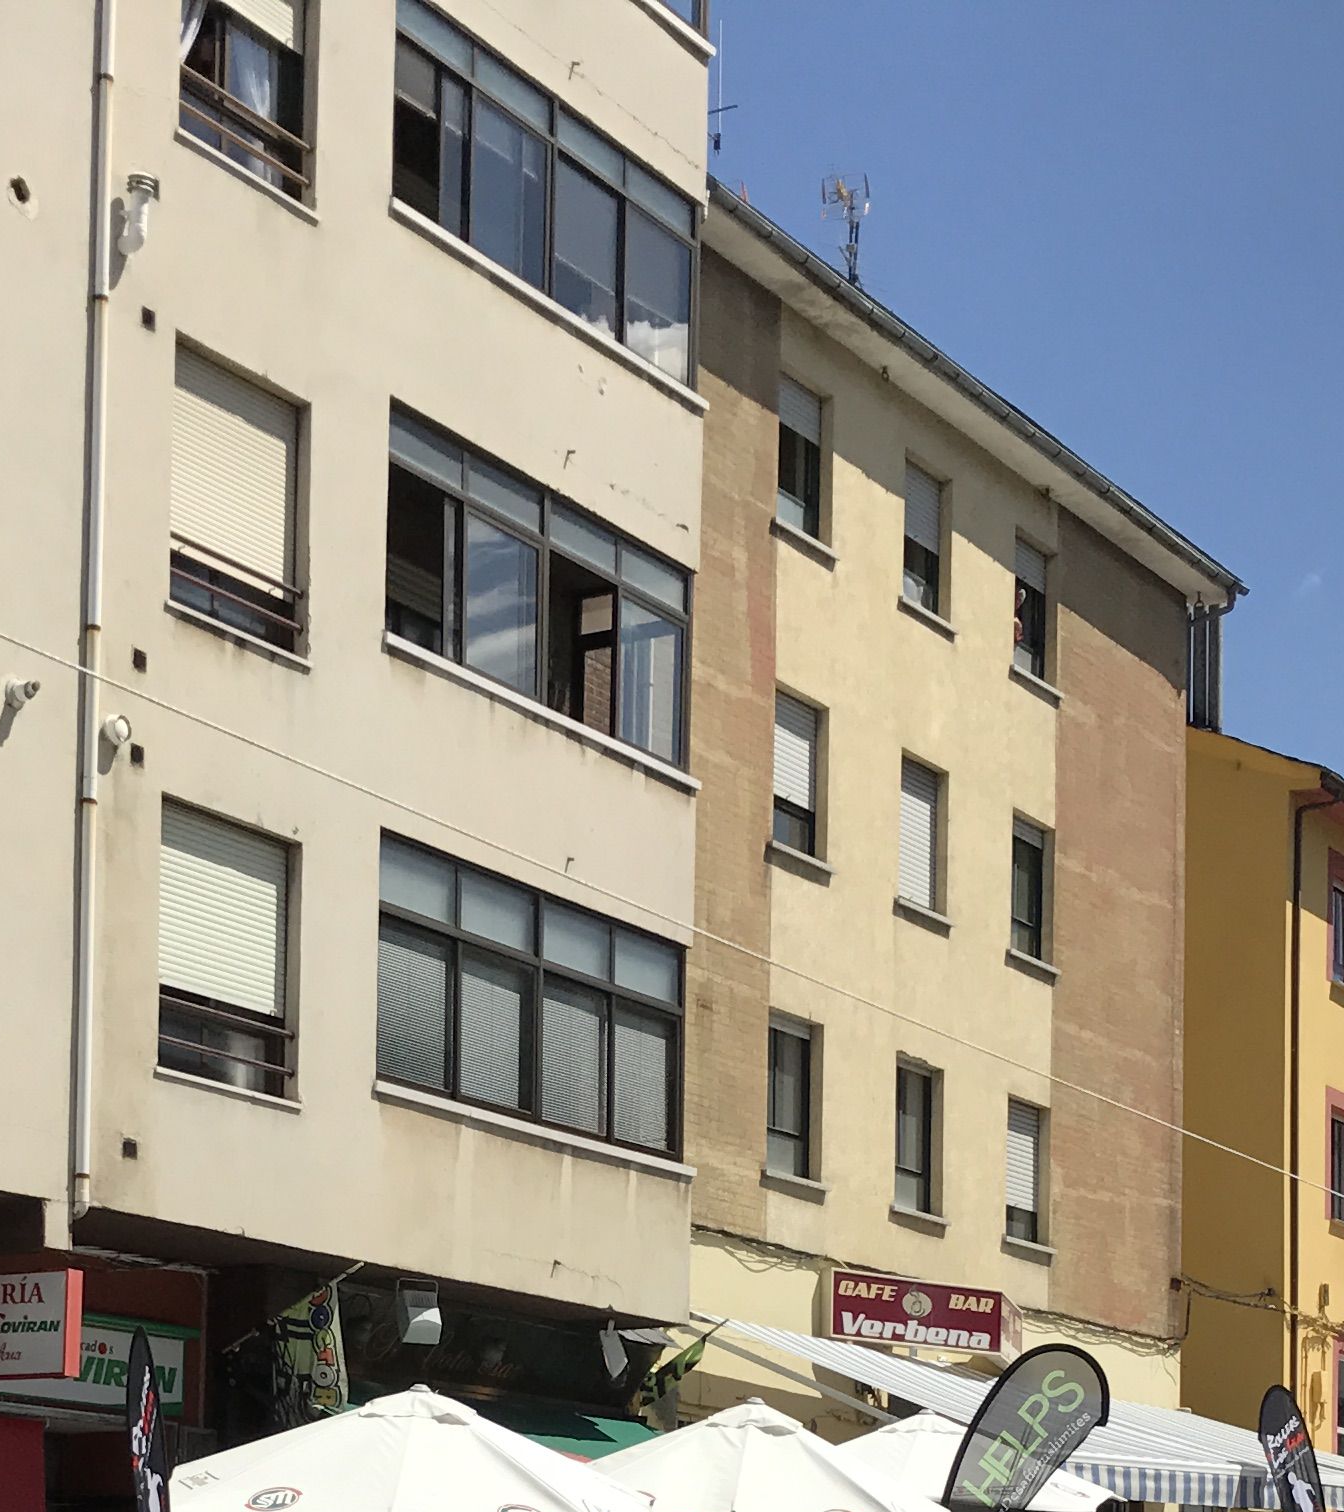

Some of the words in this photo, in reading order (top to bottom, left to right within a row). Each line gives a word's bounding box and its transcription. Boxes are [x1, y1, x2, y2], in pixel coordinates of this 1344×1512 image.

[838, 1280, 899, 1302] CAFE
[948, 1293, 995, 1314] BAR
[841, 1311, 992, 1349] Verbena
[962, 1370, 1085, 1508] HELPS
